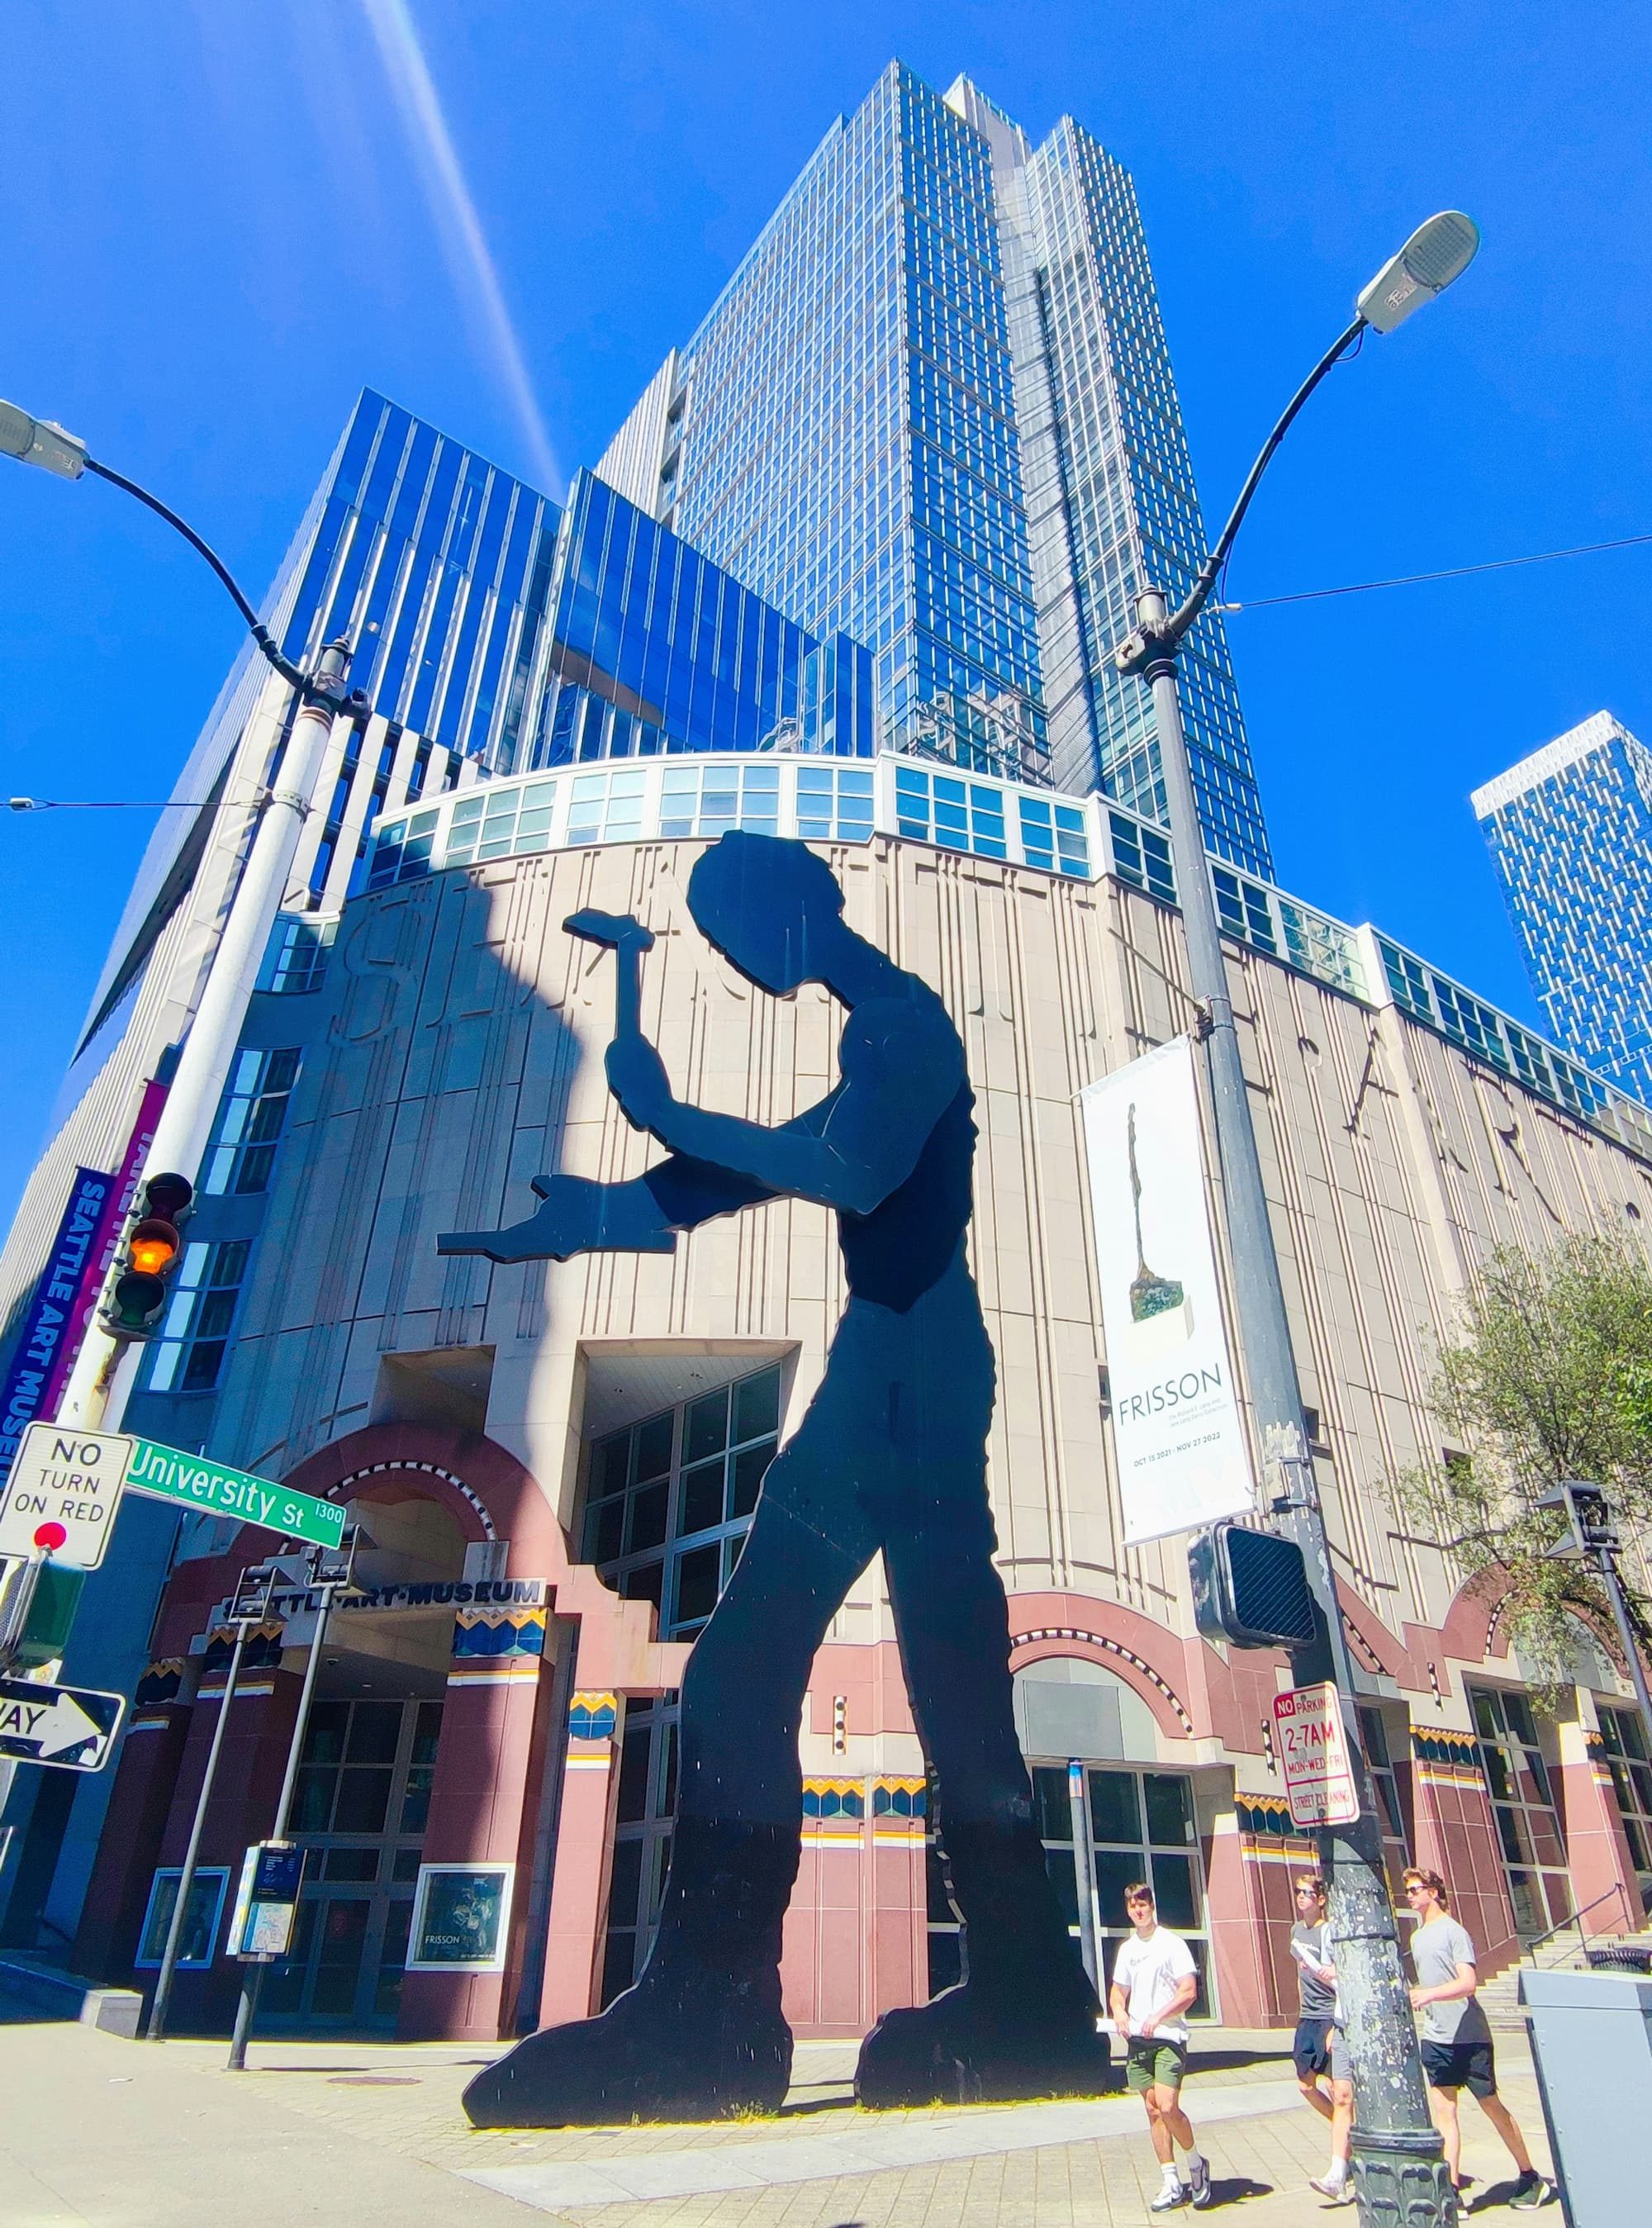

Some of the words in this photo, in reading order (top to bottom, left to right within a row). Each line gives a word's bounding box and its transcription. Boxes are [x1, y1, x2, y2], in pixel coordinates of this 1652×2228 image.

[47, 1180, 105, 1301] SEATTLE
[27, 1303, 64, 1367] ART
[1119, 1362, 1222, 1426] FRISSON
[50, 1438, 101, 1466] NO
[1133, 1458, 1146, 1467] OCT
[1156, 1449, 1171, 1460] 2021
[1176, 1442, 1191, 1452] NOV
[1203, 1432, 1221, 1443] 2022
[39, 1469, 100, 1494] TURN
[129, 1441, 277, 1522] University
[282, 1503, 305, 1528] St
[315, 1503, 343, 1524] 1300
[15, 1494, 47, 1514] ON
[59, 1499, 103, 1522] RED
[407, 1581, 539, 1605] MUSEUM
[0, 1703, 46, 1734] AY
[1277, 1699, 1294, 1716] NO
[1296, 1698, 1332, 1715] PARKING
[1285, 1720, 1336, 1751] 2-7AM
[1294, 1794, 1313, 1810] STREET
[425, 1935, 460, 1945] FRISSON
